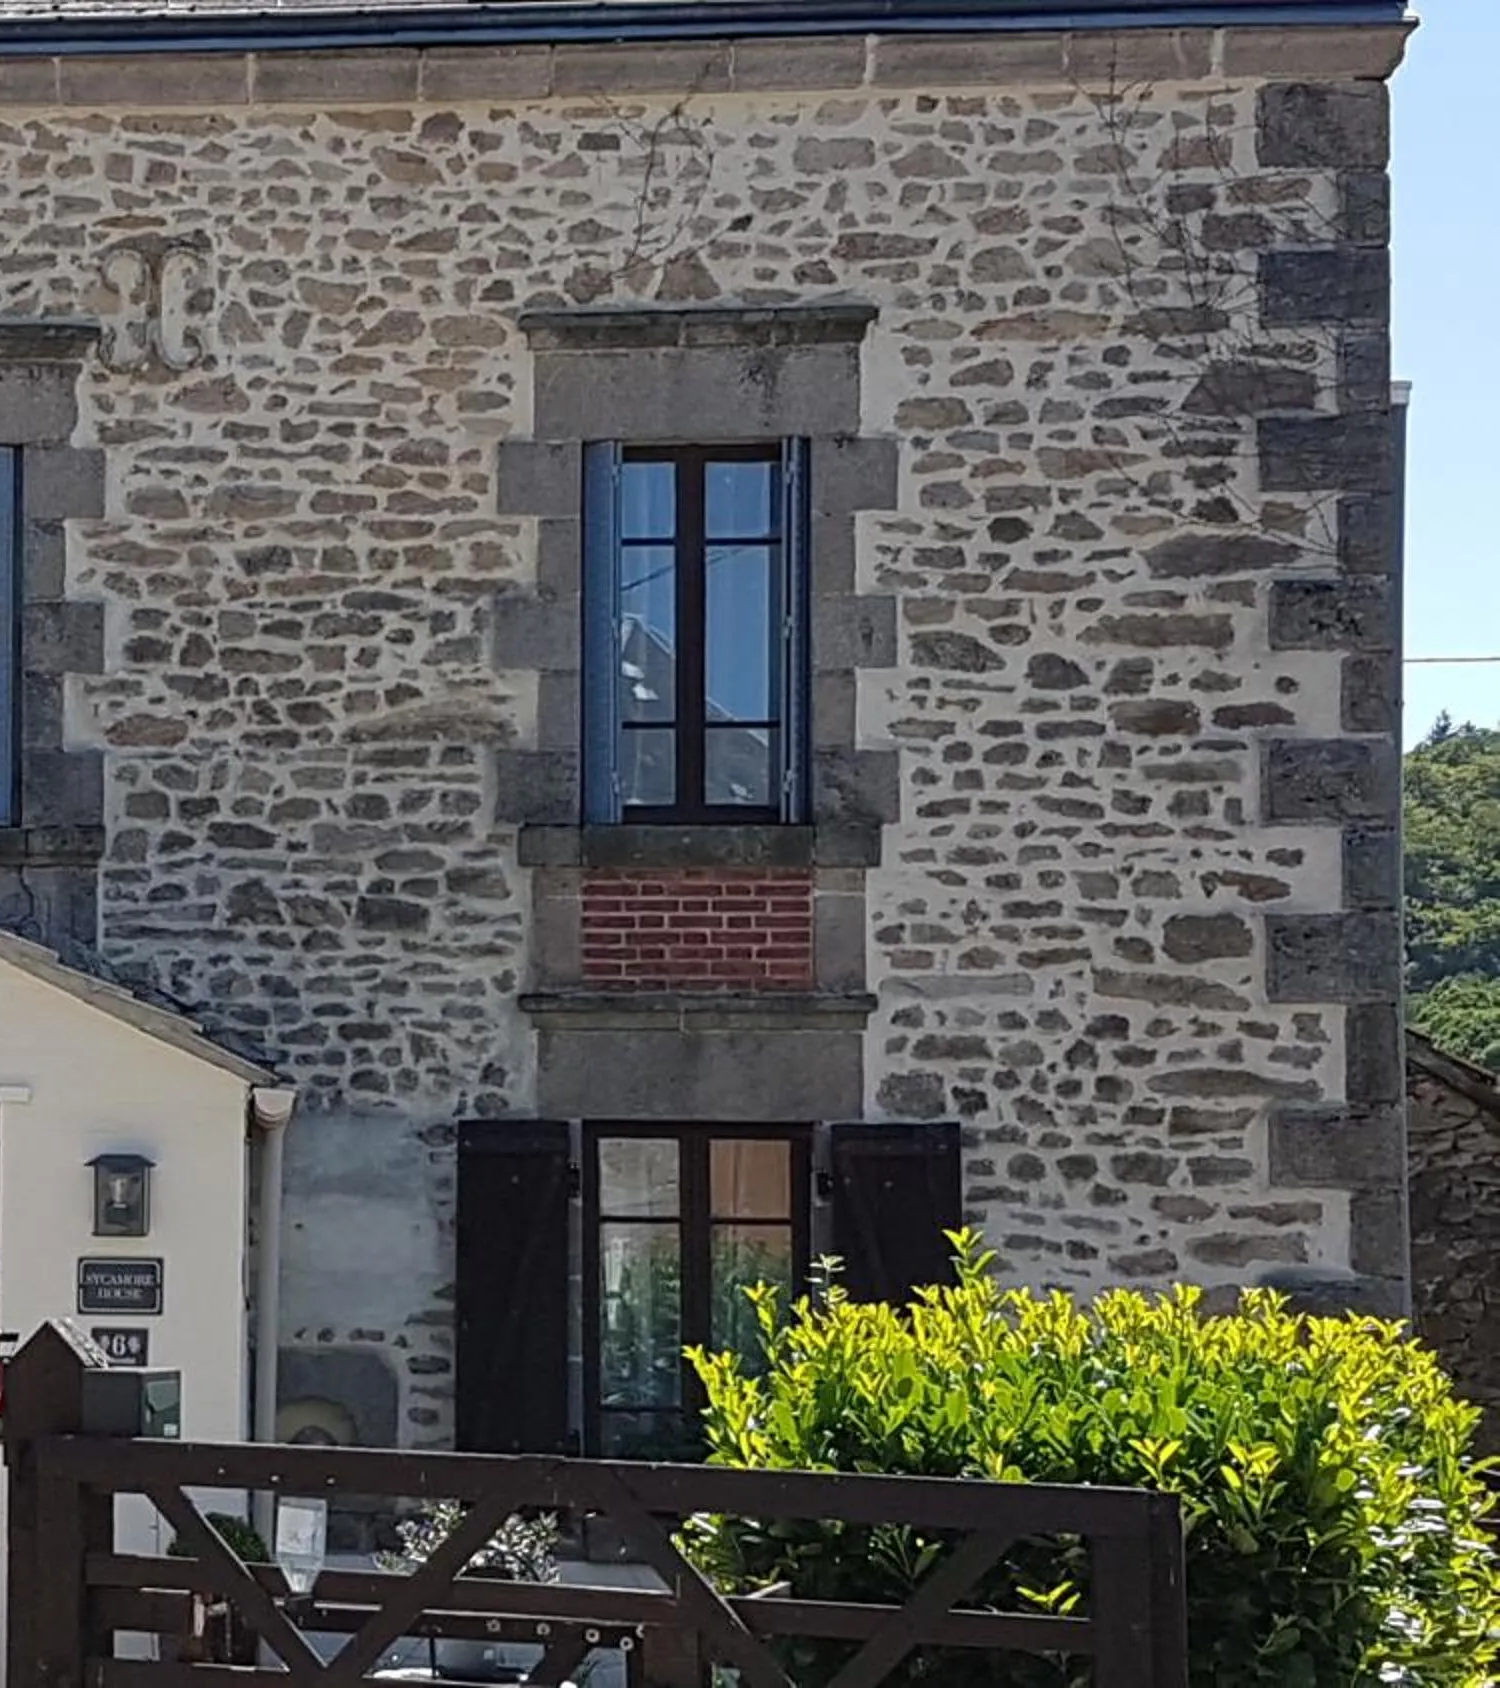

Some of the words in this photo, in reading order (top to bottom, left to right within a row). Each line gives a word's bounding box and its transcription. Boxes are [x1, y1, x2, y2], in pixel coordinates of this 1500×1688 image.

[84, 1273, 154, 1285] SYCAMORE
[97, 1287, 142, 1299] HOUSE
[112, 1334, 126, 1356] 6
